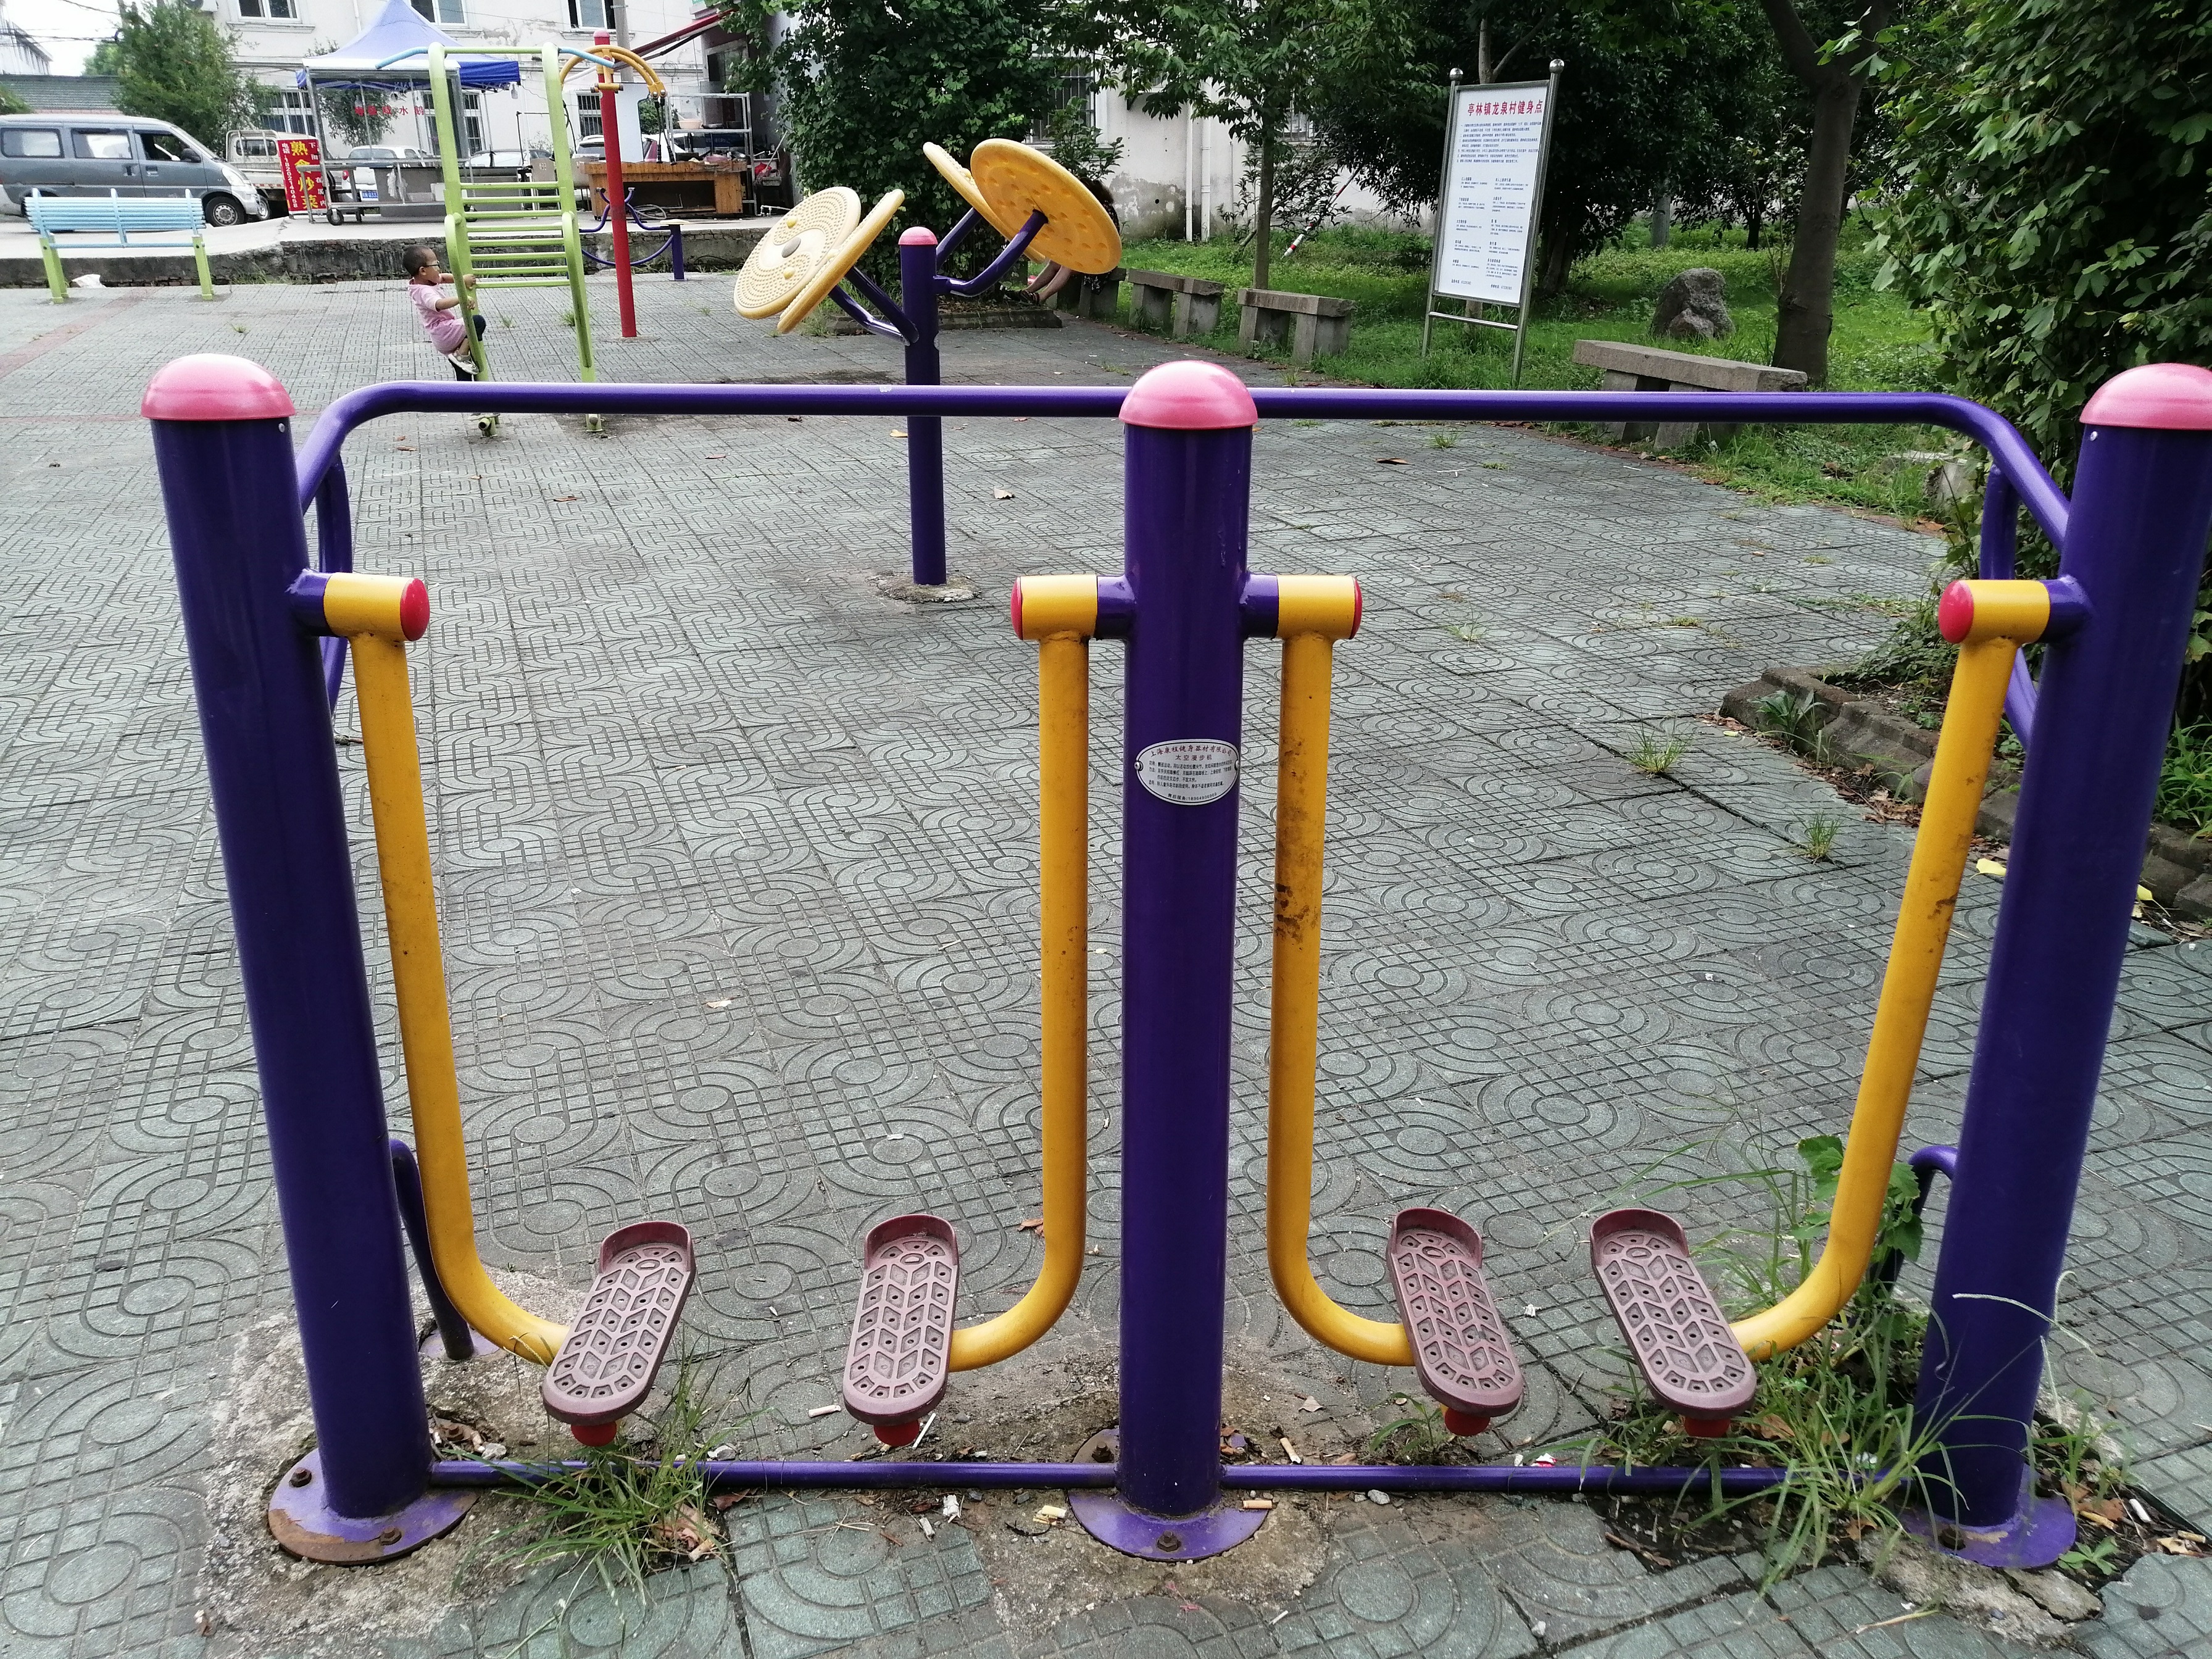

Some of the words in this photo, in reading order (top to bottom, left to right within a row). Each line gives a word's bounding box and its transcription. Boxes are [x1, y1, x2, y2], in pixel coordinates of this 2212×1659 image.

[1467, 99, 1544, 117] 亭林镇龙泉村健身点
